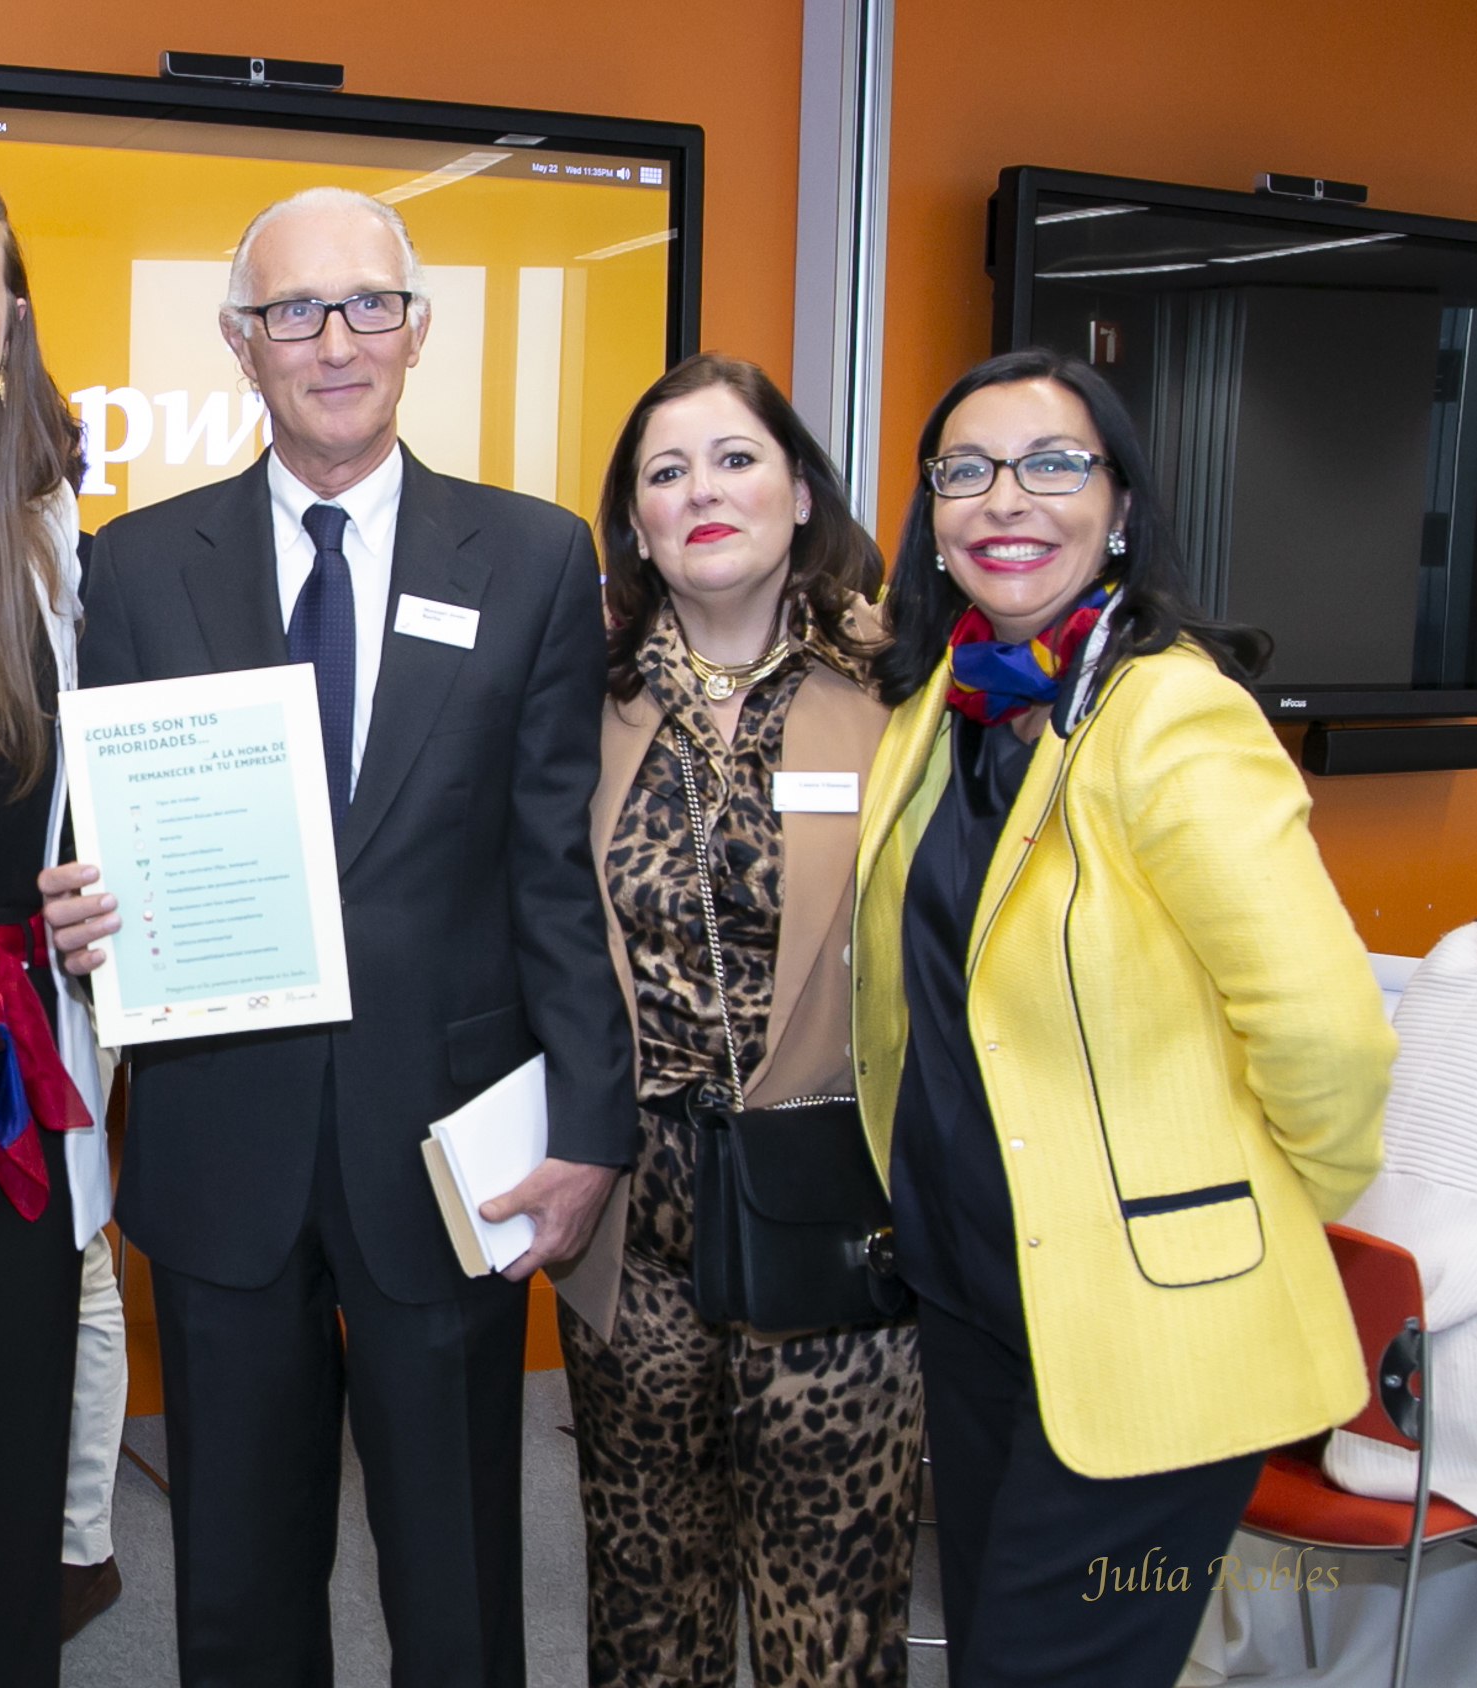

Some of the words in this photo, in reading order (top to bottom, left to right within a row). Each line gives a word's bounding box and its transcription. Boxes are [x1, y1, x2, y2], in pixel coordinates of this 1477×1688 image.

[532, 163, 548, 174] May
[548, 163, 558, 173] 22
[565, 165, 582, 175] Wed
[70, 385, 273, 495] pw
[85, 724, 147, 742] ¿CUÁLES
[153, 718, 184, 732] SON
[190, 713, 218, 728] TUS
[98, 733, 210, 757] PRIORIDADES...
[222, 748, 235, 758] LA
[238, 744, 268, 756] HORA
[272, 741, 285, 751] DE
[128, 765, 196, 783] PERMANECER
[199, 762, 213, 773] EN
[217, 761, 231, 771] TU
[234, 753, 287, 770] EMPRESA?
